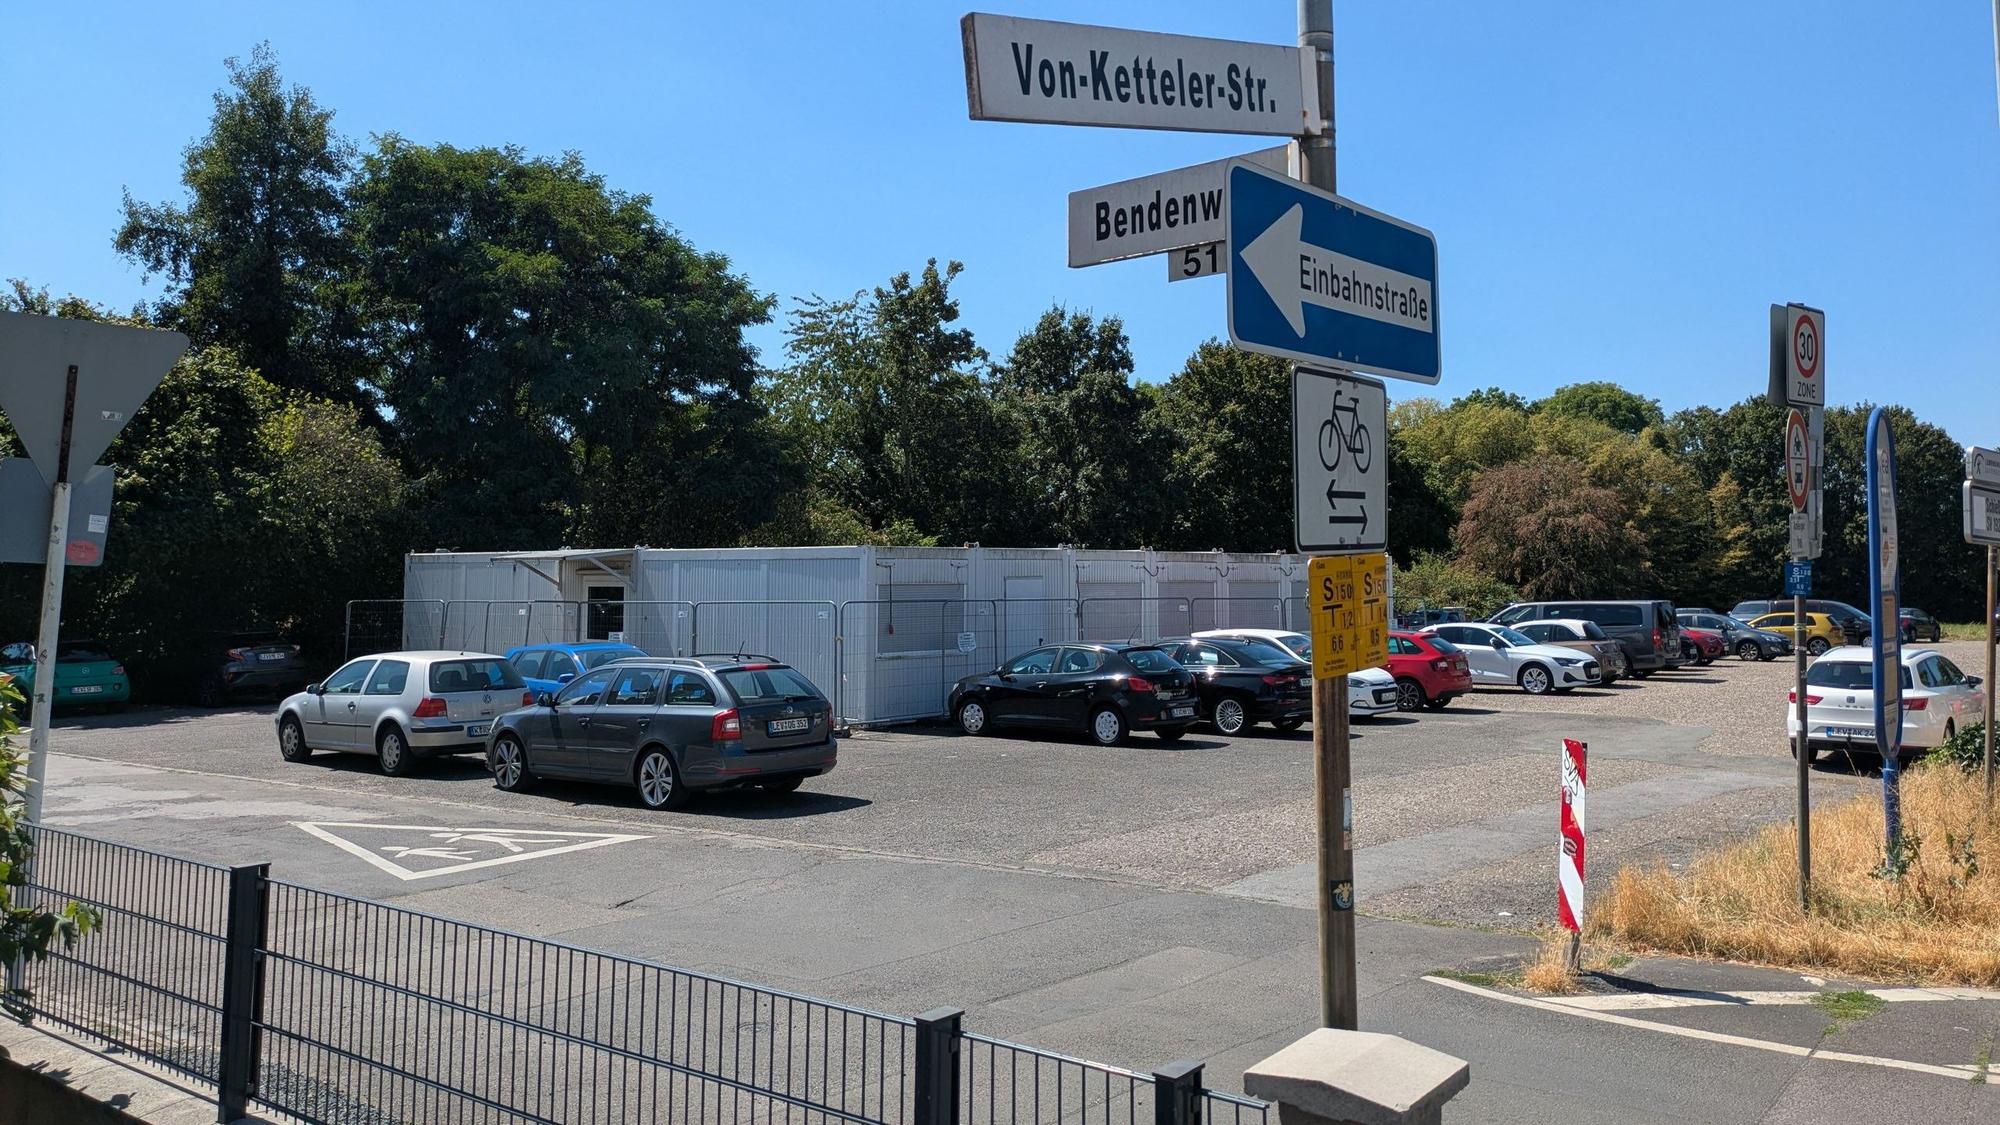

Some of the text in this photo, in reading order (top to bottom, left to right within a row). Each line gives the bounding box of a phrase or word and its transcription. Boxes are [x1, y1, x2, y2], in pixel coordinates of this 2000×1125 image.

[1011, 42, 1277, 113] Von-Ketteler-Str.
[1095, 188, 1223, 241] Bendenw
[1183, 245, 1218, 277] 51
[1300, 254, 1428, 321] Einbahnstraße
[1799, 331, 1814, 361] 30
[1797, 381, 1816, 399] ZONE
[1323, 577, 1353, 602] S 150
[1364, 572, 1373, 596] S
[1323, 604, 1343, 627] T
[1364, 599, 1379, 620] T
[772, 721, 784, 732] LEV
[796, 718, 808, 729] 352
